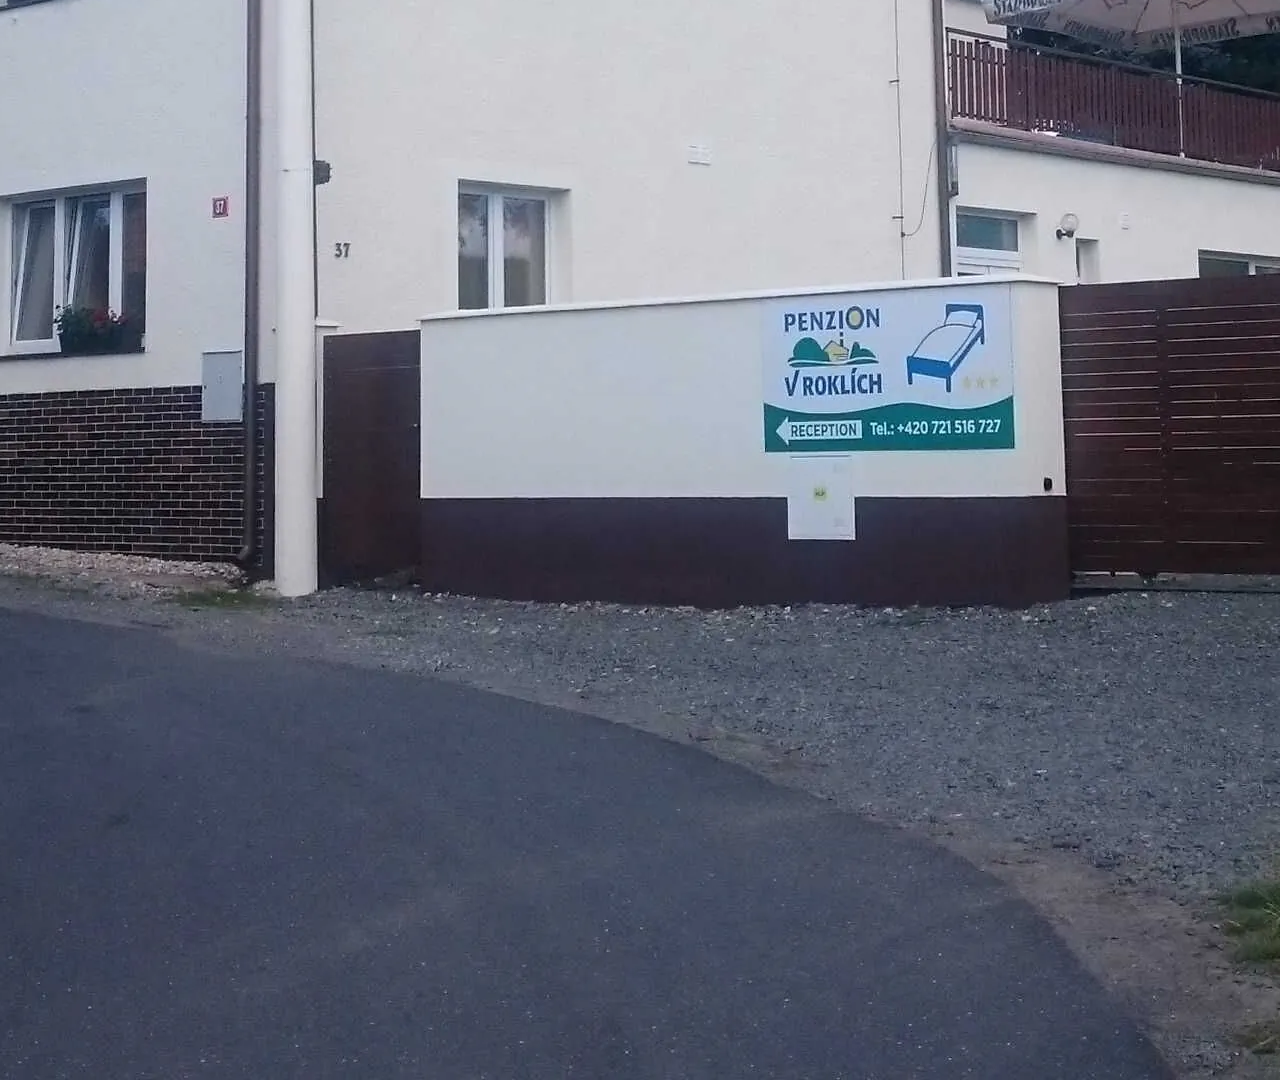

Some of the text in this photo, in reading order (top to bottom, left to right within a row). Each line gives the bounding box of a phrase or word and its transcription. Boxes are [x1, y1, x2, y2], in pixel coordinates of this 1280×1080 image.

[214, 200, 225, 214] 37
[334, 243, 351, 258] 37
[784, 305, 880, 333] PENZION
[784, 367, 883, 397] V ROKLÍCH
[790, 419, 1002, 438] RECEPTION Tel.: +420 721 516 727
